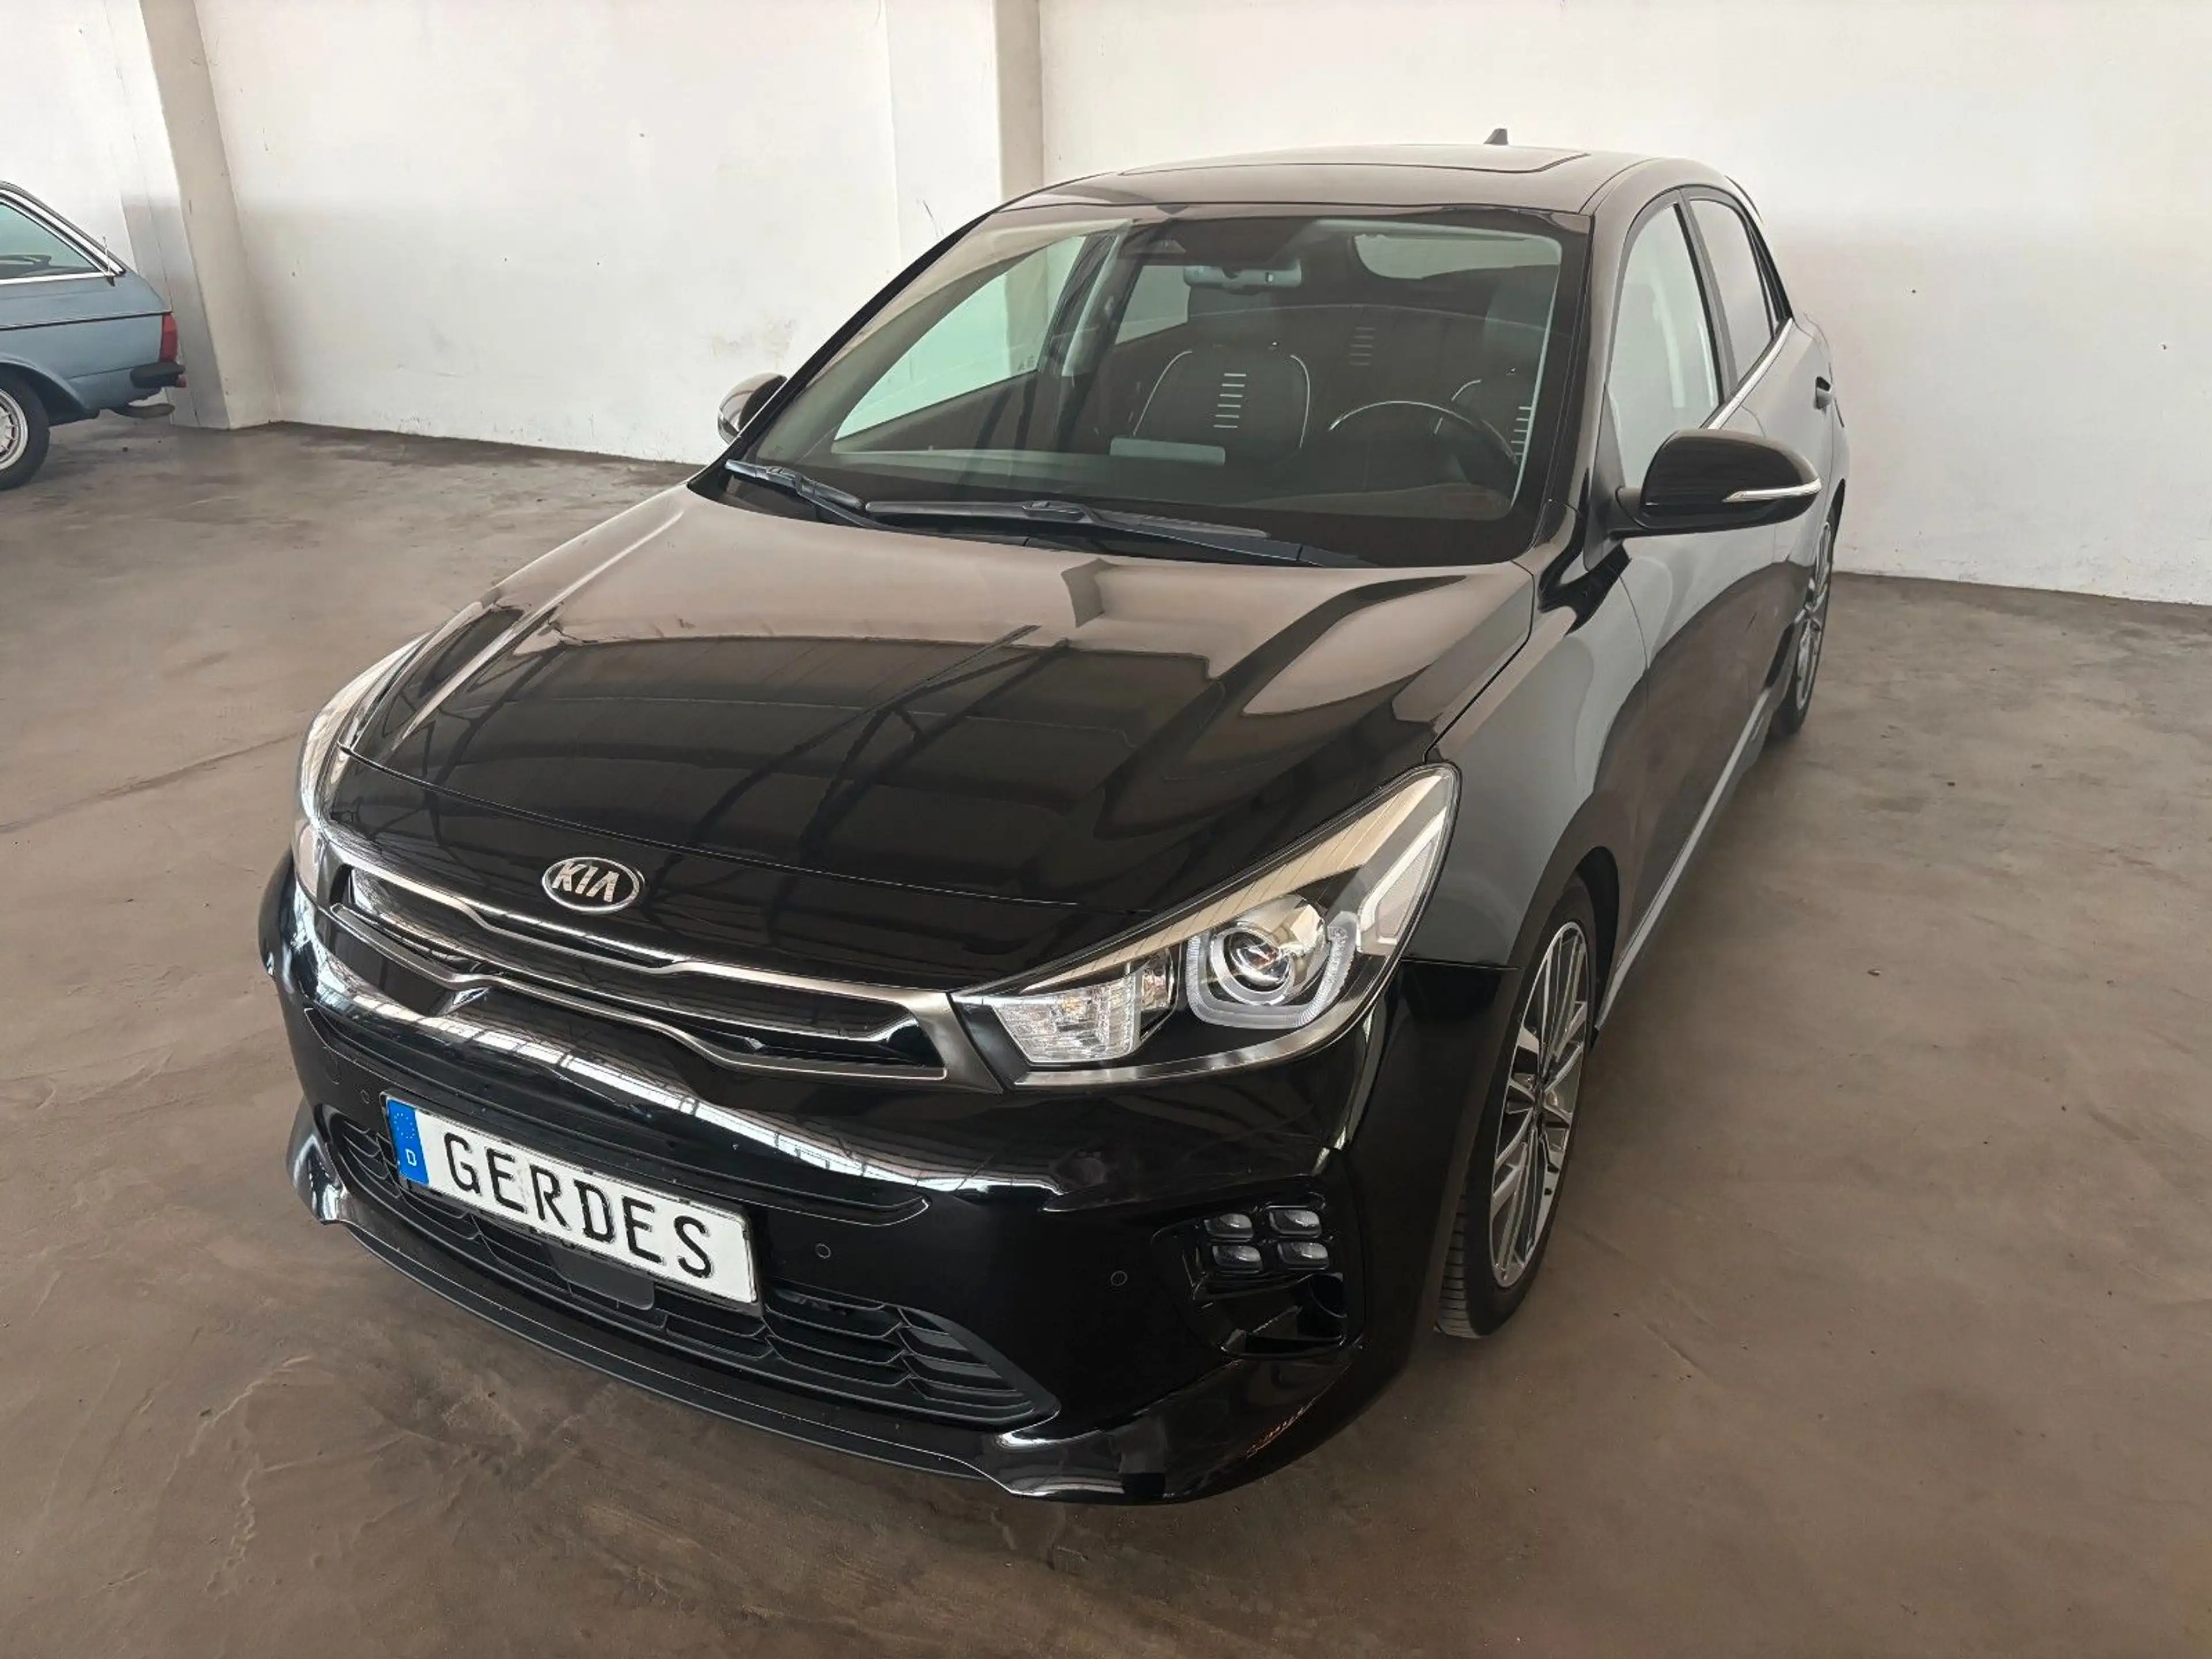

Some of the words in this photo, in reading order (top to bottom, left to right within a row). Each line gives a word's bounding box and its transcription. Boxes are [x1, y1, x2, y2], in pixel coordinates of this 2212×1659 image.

[552, 861, 620, 903] KIA
[406, 1149, 417, 1166] D
[444, 1132, 714, 1279] GERDES
